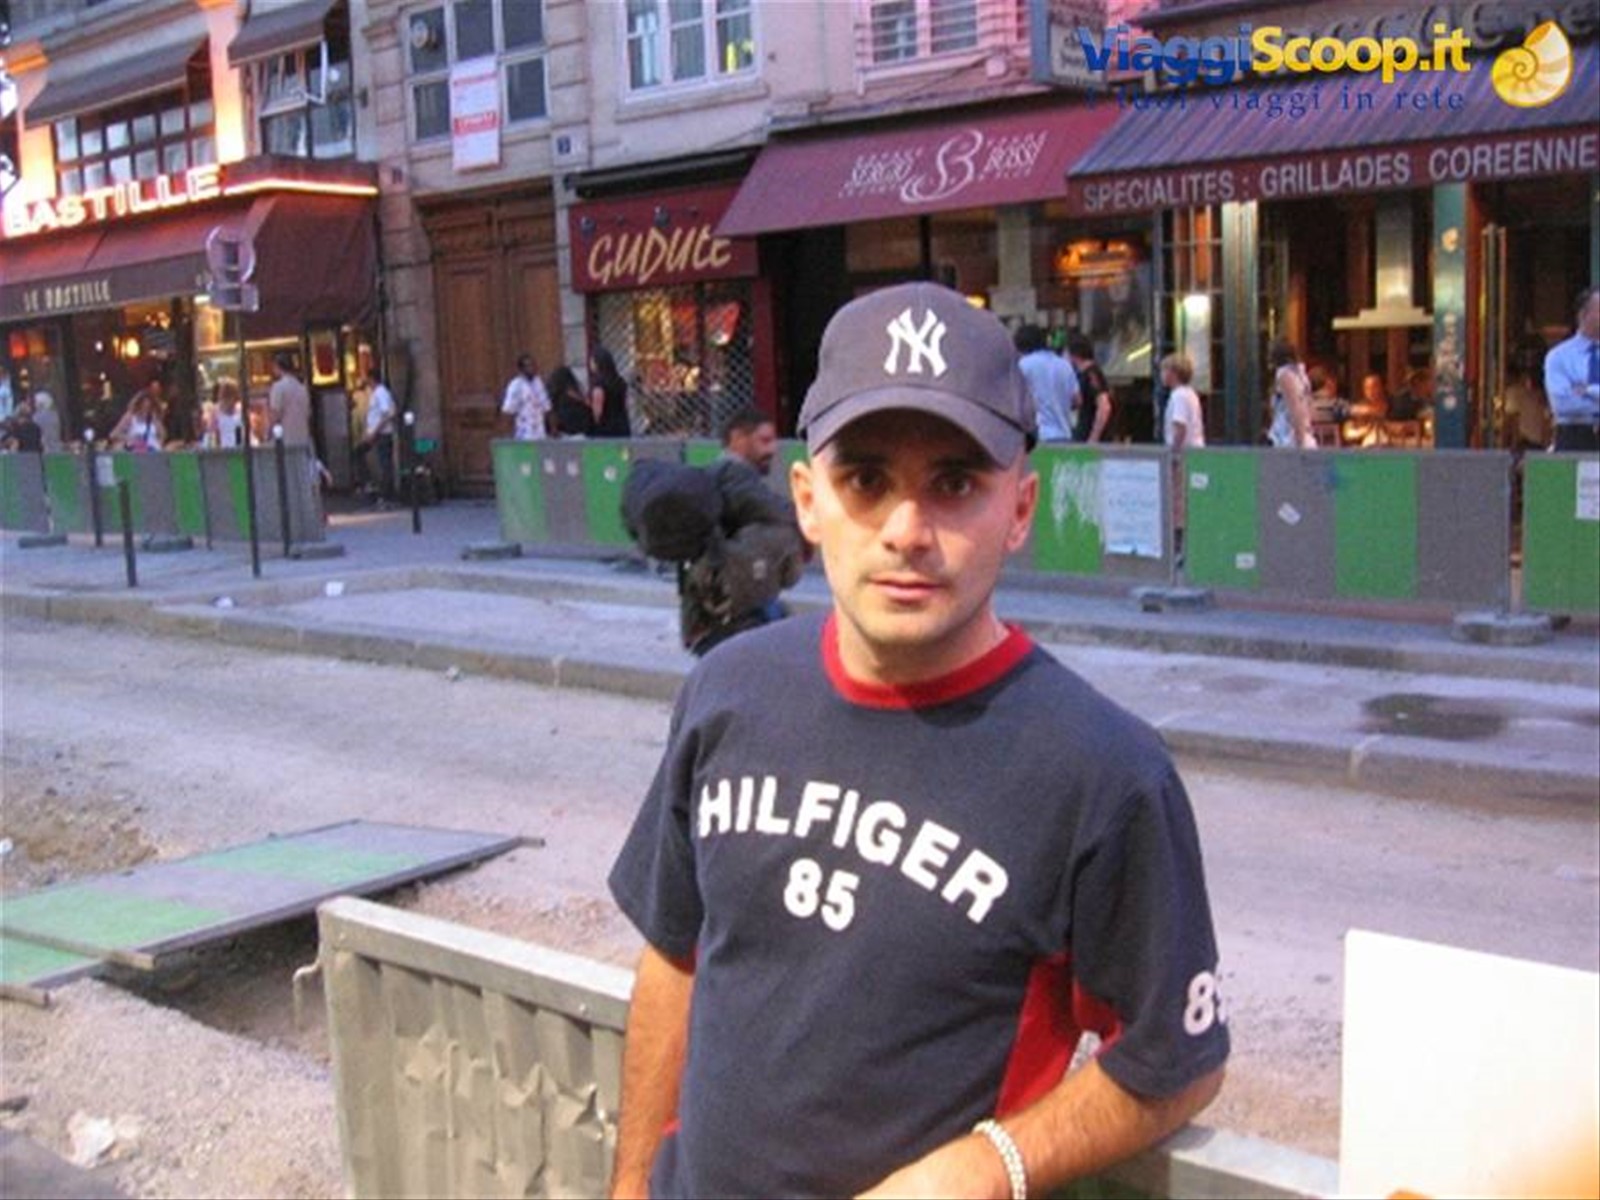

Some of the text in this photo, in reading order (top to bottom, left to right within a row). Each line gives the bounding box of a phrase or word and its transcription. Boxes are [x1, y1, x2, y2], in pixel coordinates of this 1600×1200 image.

[3, 164, 221, 238] BASTILLE
[1083, 169, 1236, 210] SPECIALITES
[1259, 151, 1411, 198] GRILLADES
[1428, 133, 1599, 181] COREENNE
[883, 307, 947, 377] NY
[697, 776, 1009, 924] HILFIGER
[783, 858, 860, 931] 85
